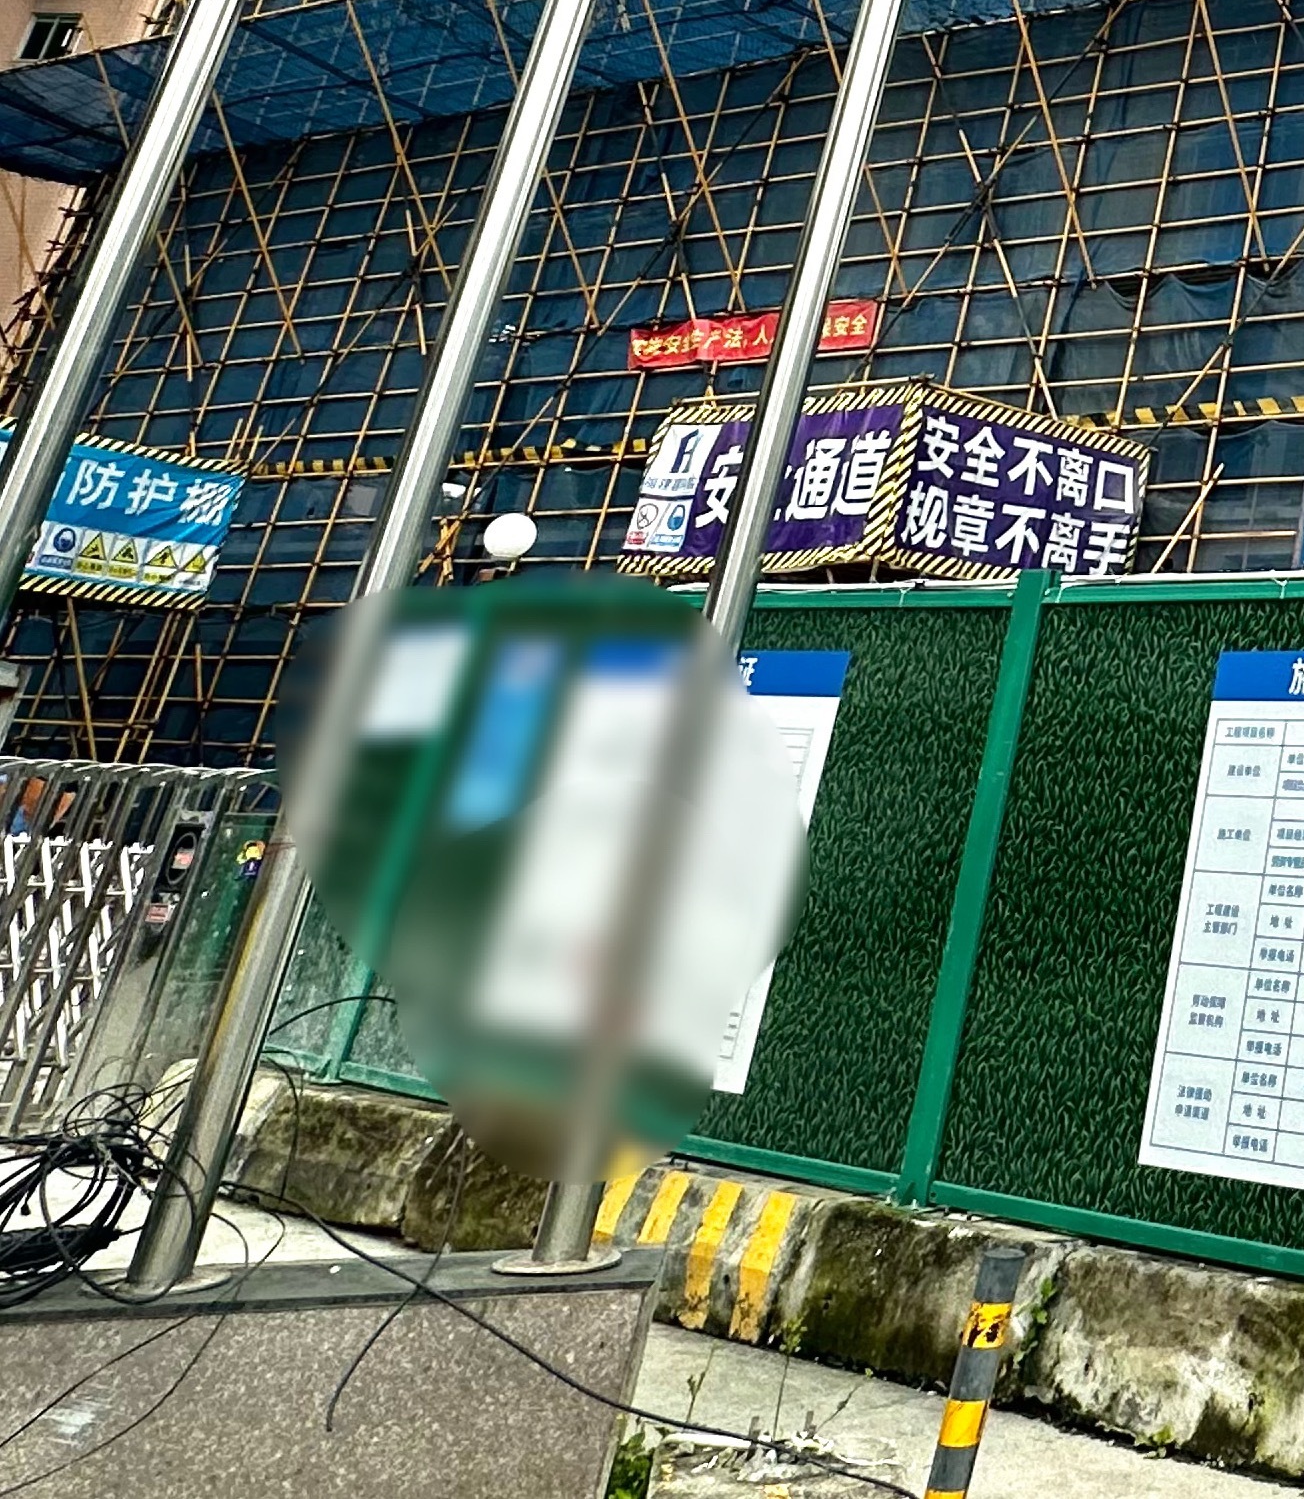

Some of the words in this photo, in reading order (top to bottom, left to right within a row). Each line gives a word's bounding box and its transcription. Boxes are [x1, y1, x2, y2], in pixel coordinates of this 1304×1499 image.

[695, 429, 893, 529] 安通道
[922, 415, 1135, 515] 安全不离口
[900, 483, 1132, 576] 规章不离手
